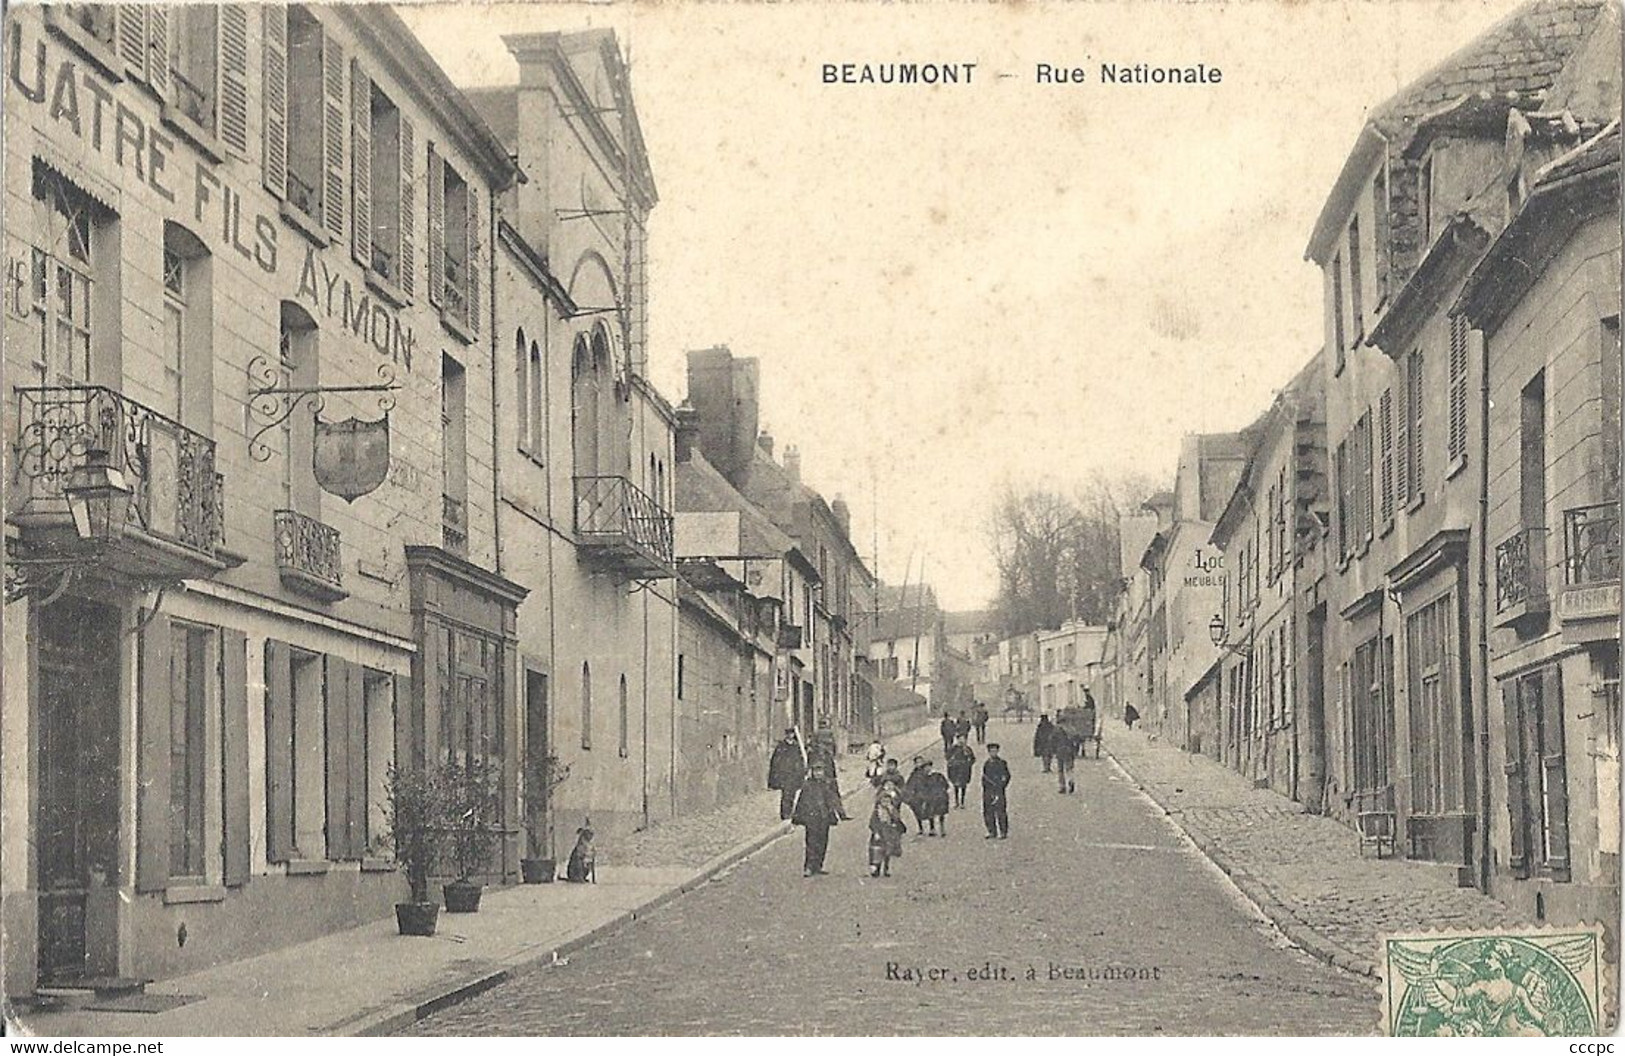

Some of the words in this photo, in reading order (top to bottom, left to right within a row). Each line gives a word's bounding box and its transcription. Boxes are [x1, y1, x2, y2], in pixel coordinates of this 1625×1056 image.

[822, 64, 977, 84] BEAUMONT
[1036, 64, 1085, 84] Rue
[1101, 64, 1223, 84] Nationale
[195, 162, 278, 274] FILS
[295, 245, 415, 374] AYMON
[967, 962, 1016, 982] edit.
[1048, 962, 1161, 982] Beaumont
